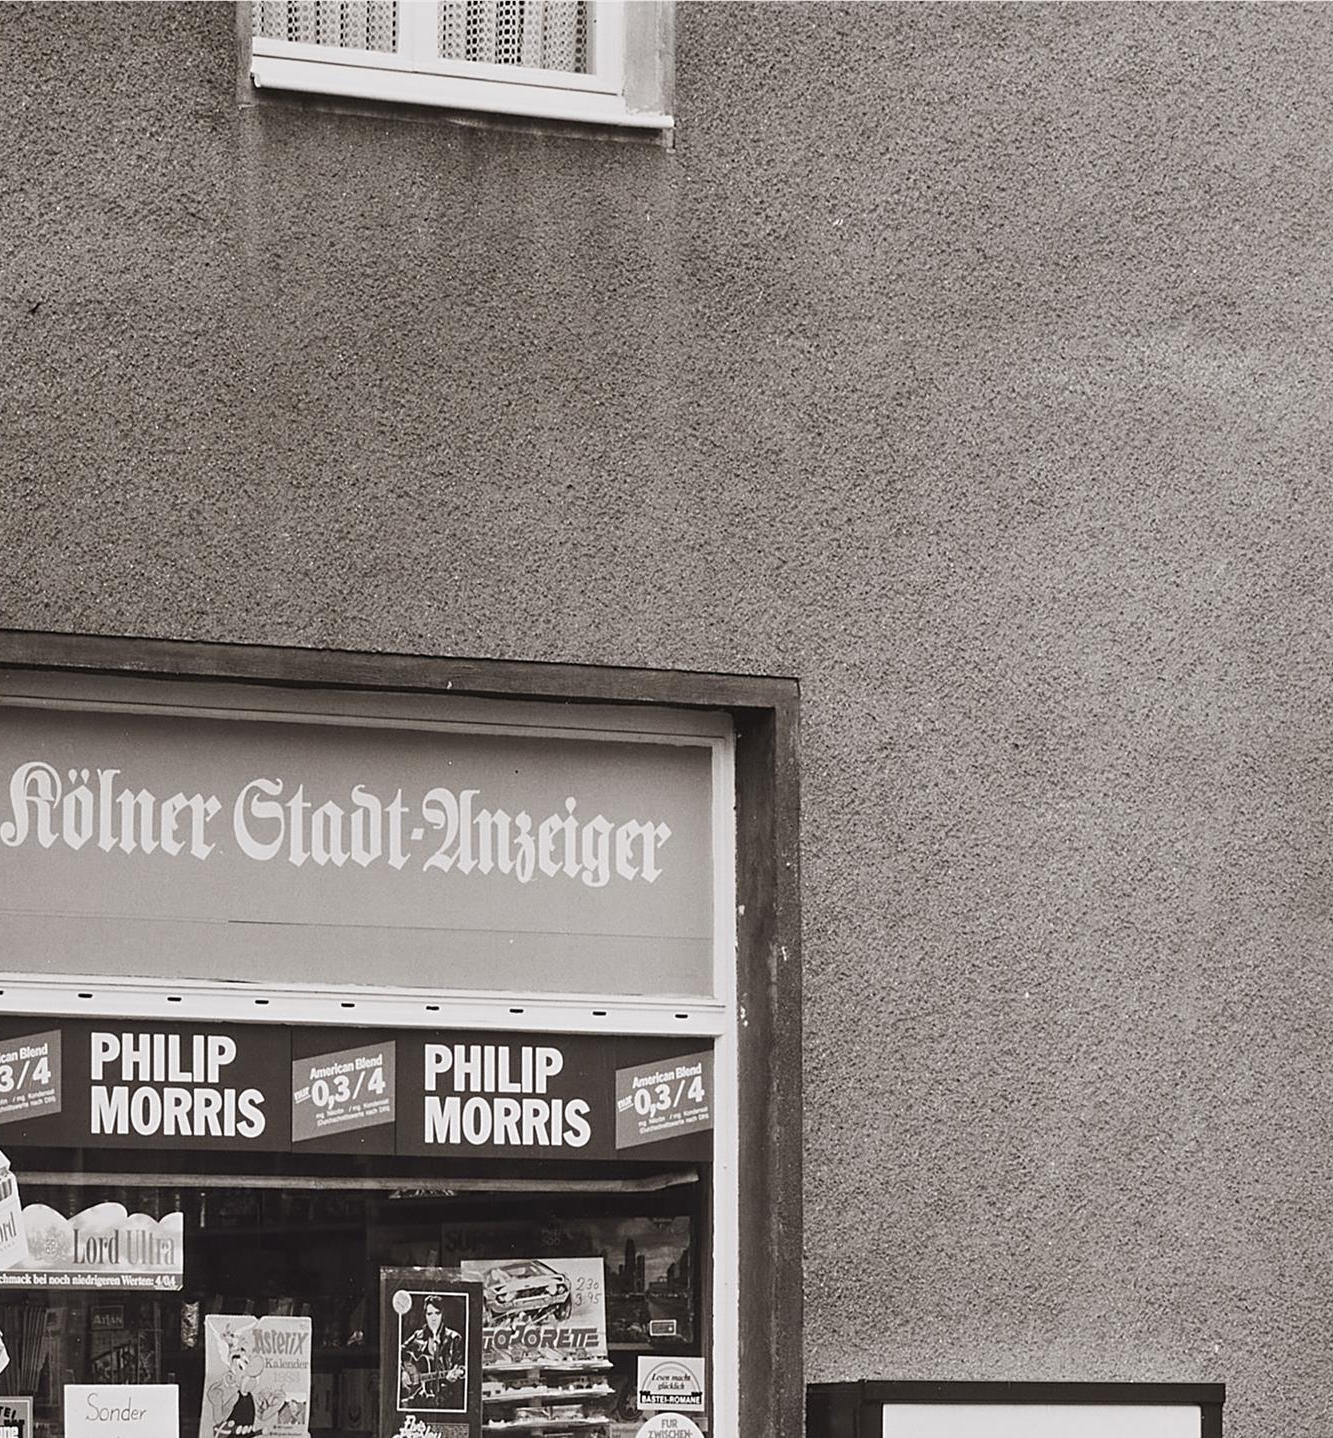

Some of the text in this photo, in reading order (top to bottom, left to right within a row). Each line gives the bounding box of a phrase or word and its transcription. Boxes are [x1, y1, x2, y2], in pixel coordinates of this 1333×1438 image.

[0, 760, 672, 887] Kölner Stadt-Anzeiger
[19, 1043, 48, 1057] Blend
[91, 1032, 236, 1083] PHILIP
[310, 1054, 383, 1080] American Blend
[424, 1043, 564, 1094] PHILIP
[632, 1062, 702, 1088] American Blend
[91, 1085, 266, 1138] MORRIS
[424, 1095, 592, 1148] MORRIS
[72, 1229, 175, 1265] Lord Ultra
[48, 1274, 71, 1285] noch
[252, 1328, 309, 1355] Asterix
[264, 1358, 309, 1369] Kalender
[85, 1392, 147, 1423] Sonder
